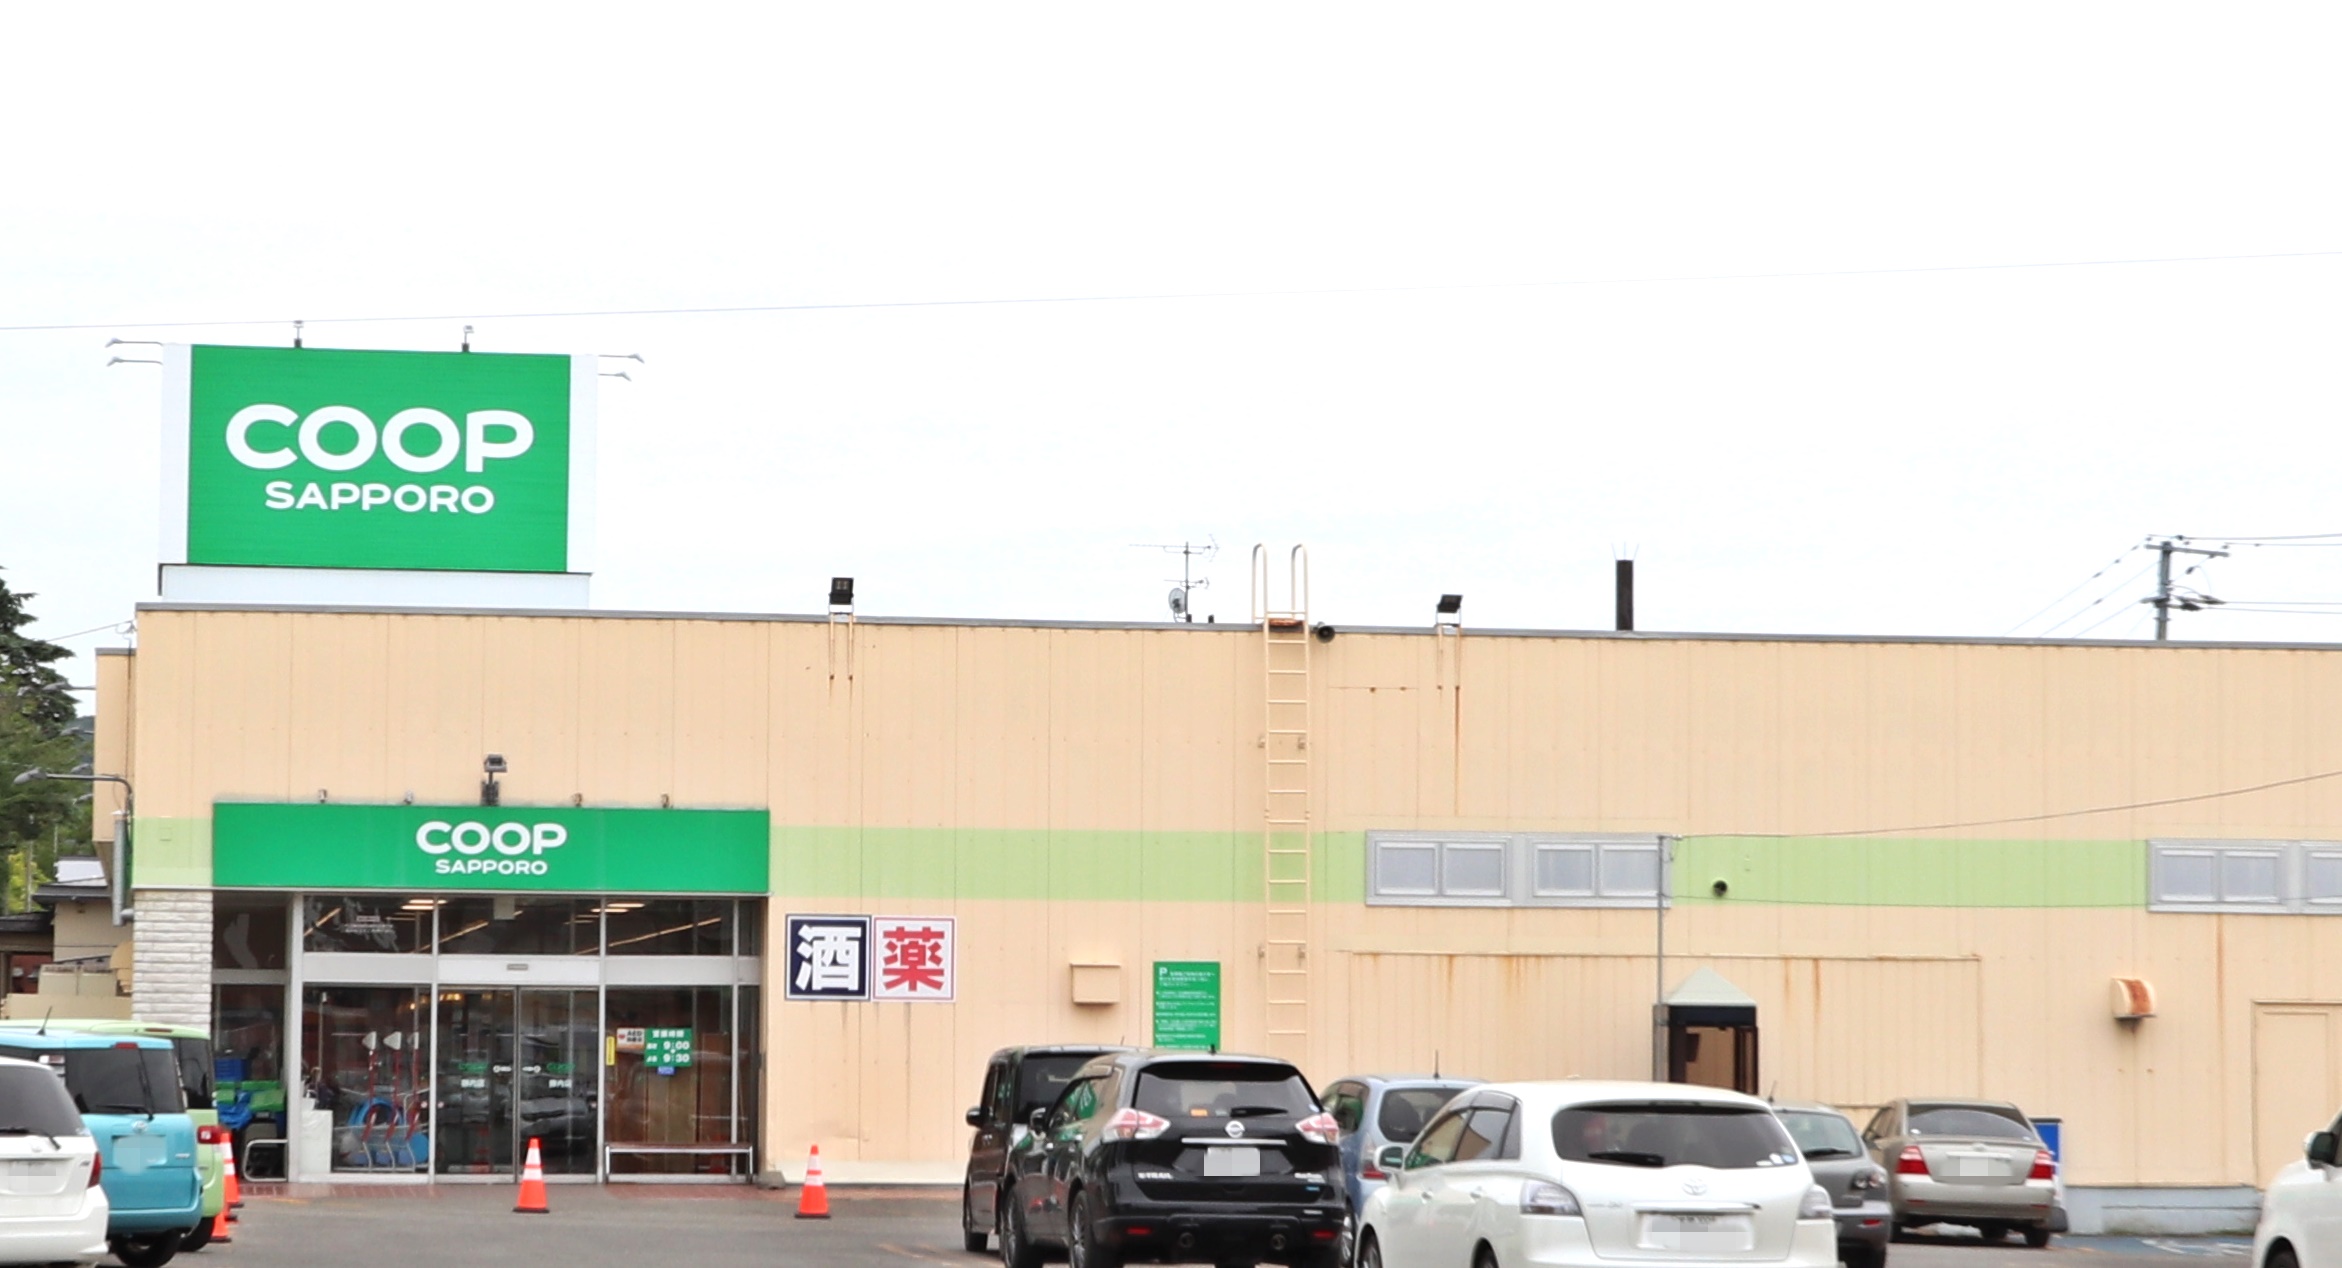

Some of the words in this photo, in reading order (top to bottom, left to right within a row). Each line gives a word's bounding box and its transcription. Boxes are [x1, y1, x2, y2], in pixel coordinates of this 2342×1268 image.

[225, 403, 535, 473] COOP
[265, 481, 495, 514] SAPPORO
[416, 821, 567, 855] COOP
[435, 859, 548, 875] SAPPORO
[795, 924, 862, 991] 酒
[883, 927, 945, 991] 薬
[1159, 967, 1169, 977] P
